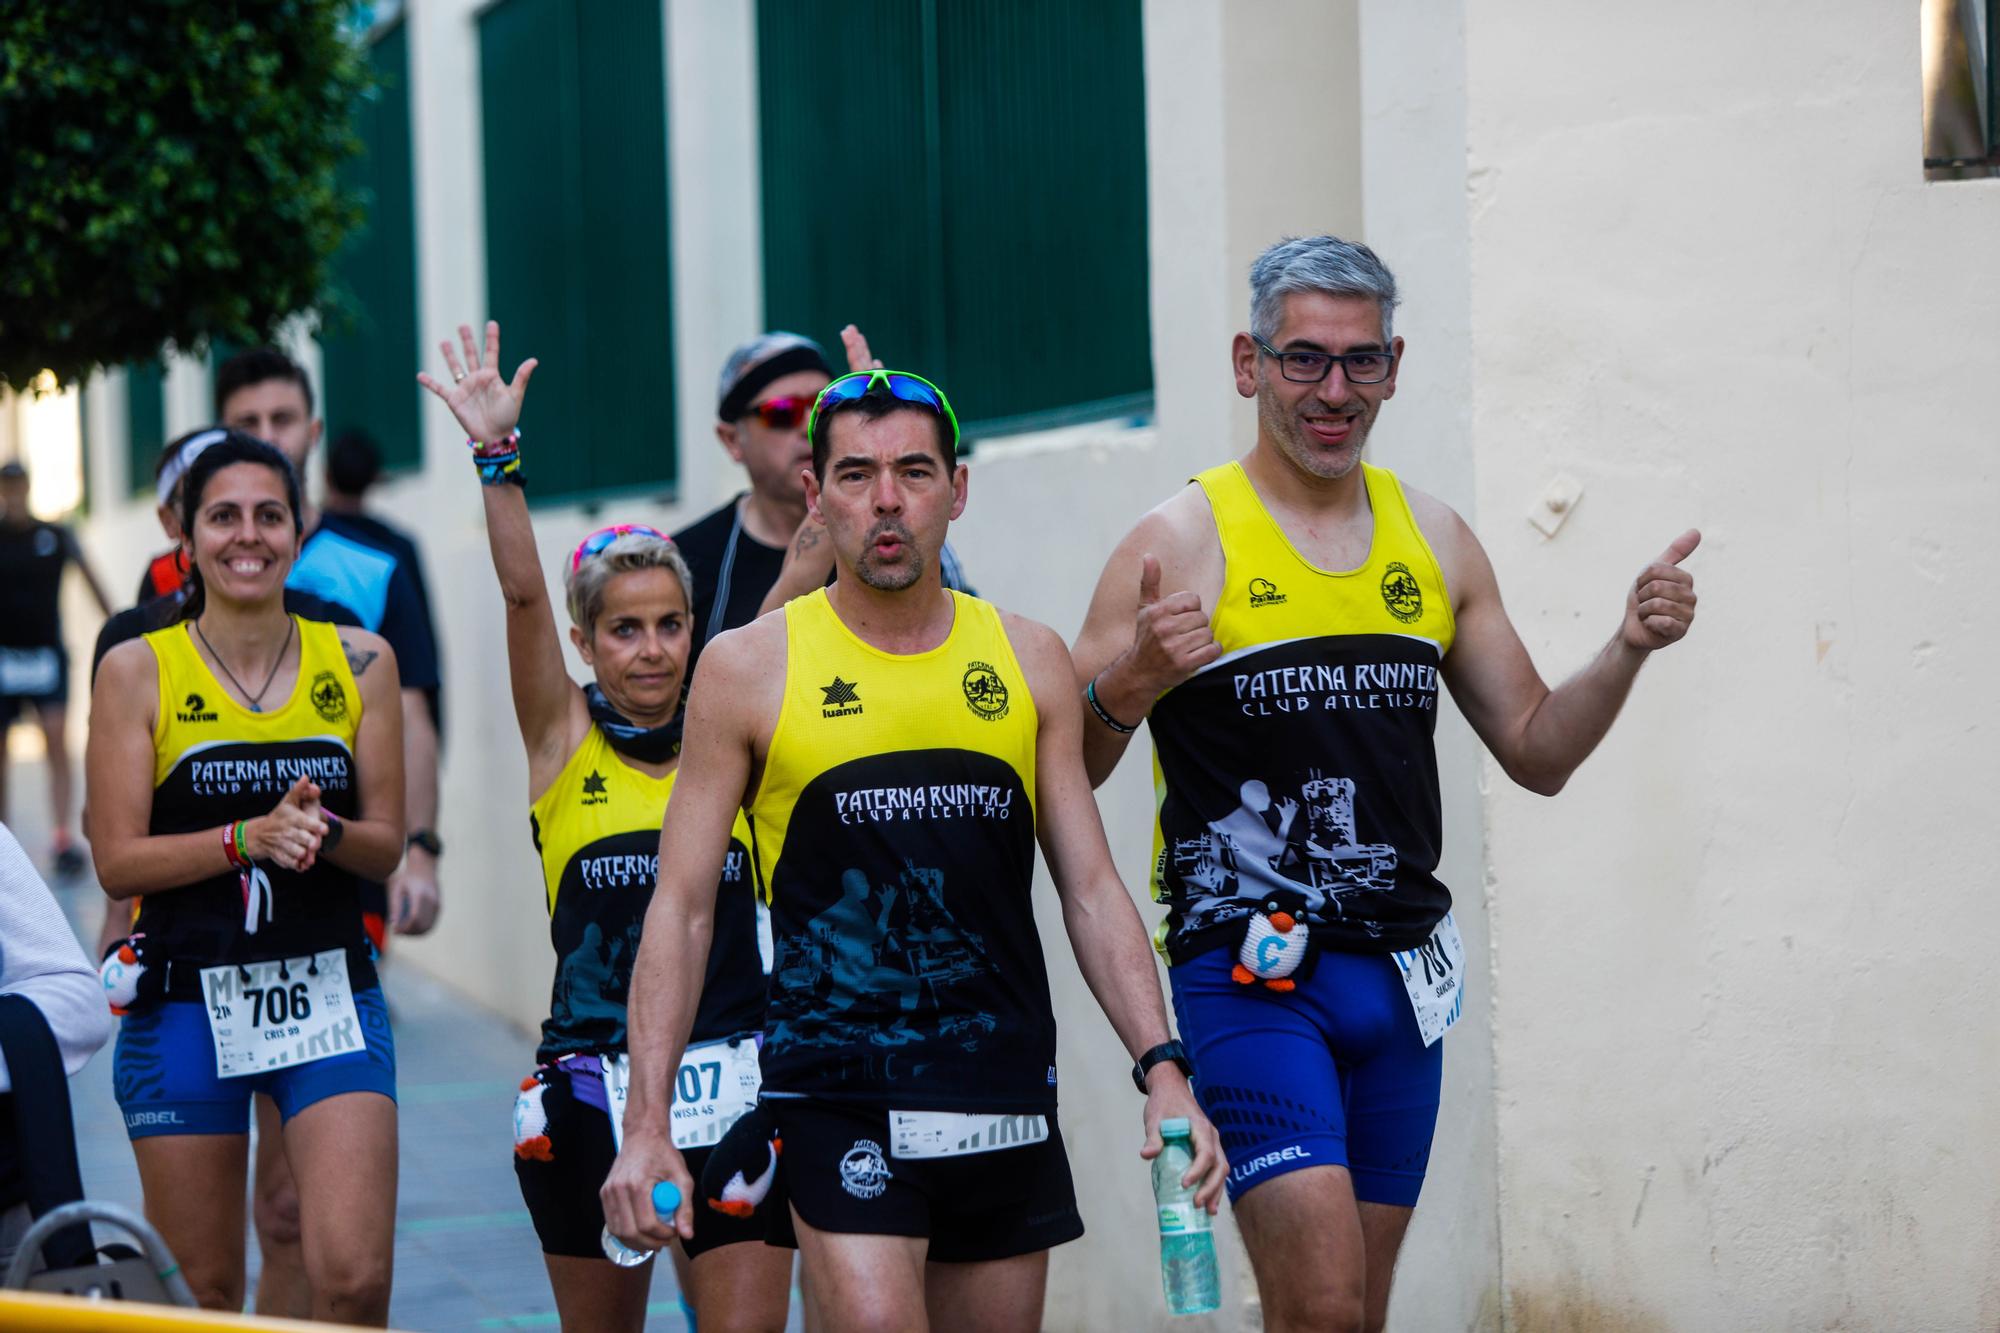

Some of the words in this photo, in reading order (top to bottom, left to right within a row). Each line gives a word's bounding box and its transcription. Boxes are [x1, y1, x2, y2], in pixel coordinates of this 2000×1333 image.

[1234, 665, 1346, 699] PATERNA
[823, 704, 863, 718] luanvi
[1242, 697, 1309, 716] CLUB
[177, 712, 218, 722] VIATOR
[191, 760, 270, 782] PATERNA
[276, 756, 348, 778] RUNNERS
[193, 782, 241, 795] CLUB
[836, 786, 925, 813] PATERNA
[930, 784, 1012, 807] RUNNERS
[841, 809, 893, 824] CLUB
[585, 875, 630, 889] CLUB
[243, 982, 311, 1028] 706
[264, 1028, 285, 1041] CRIS
[672, 1061, 721, 1104] 07
[126, 1111, 184, 1128] LURBEL
[673, 1107, 698, 1119] WISA
[1234, 1145, 1311, 1181] LURBEL
